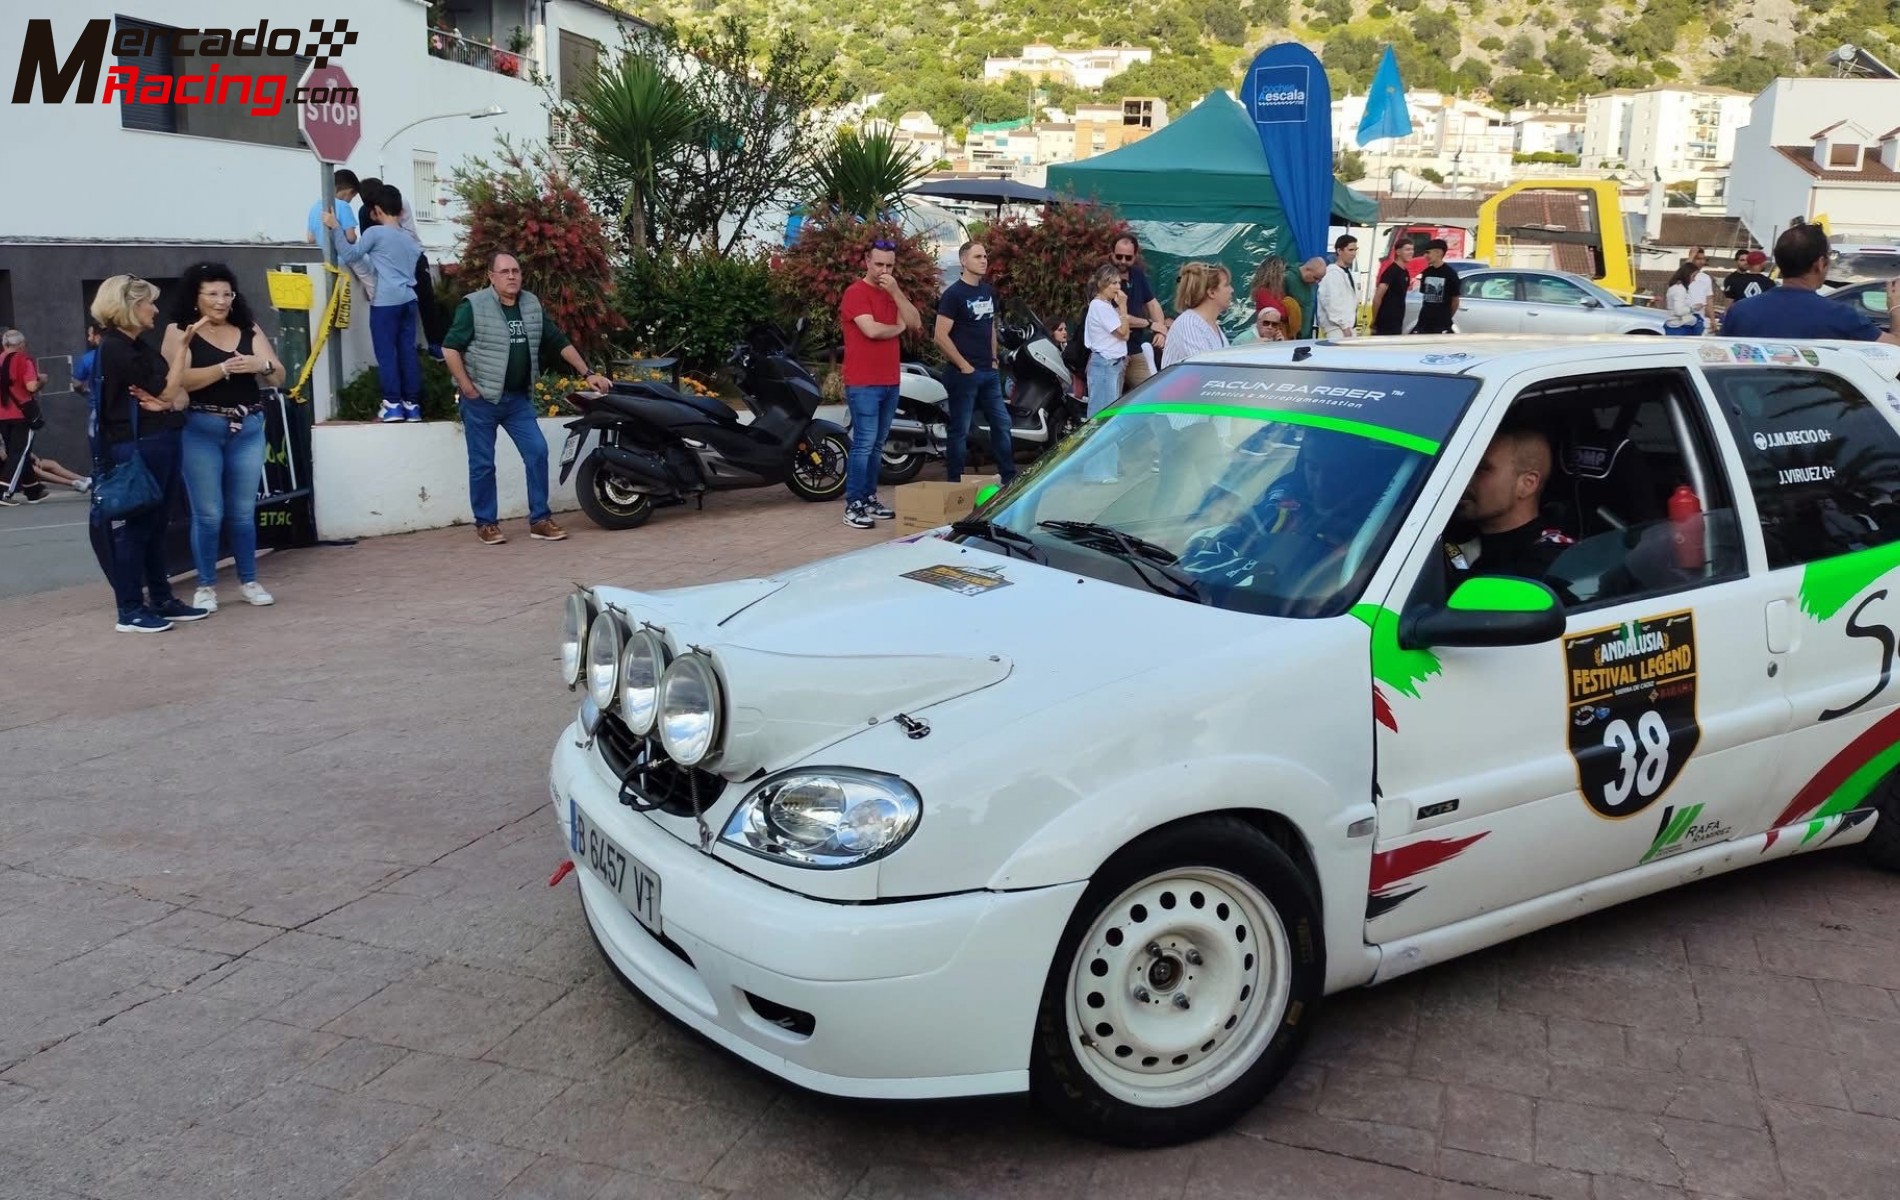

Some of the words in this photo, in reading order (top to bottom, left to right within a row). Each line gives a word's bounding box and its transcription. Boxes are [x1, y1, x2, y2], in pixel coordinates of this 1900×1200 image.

[306, 102, 359, 126] STOP
[1202, 380, 1275, 391] FACUN
[1275, 383, 1386, 401] BARBER
[1767, 429, 1818, 447] J.M.RECIO
[1778, 466, 1823, 485] J.VIRUEZ
[1601, 630, 1665, 664] ANDALUSIA
[1572, 664, 1637, 698] FESTIVAL
[1640, 644, 1693, 680] LEGEND
[1603, 710, 1670, 806] 38
[1422, 801, 1455, 817] VTS
[1685, 820, 1720, 839] RAFA
[577, 815, 586, 856] B
[590, 829, 626, 894] 6457
[633, 866, 655, 921] VT
